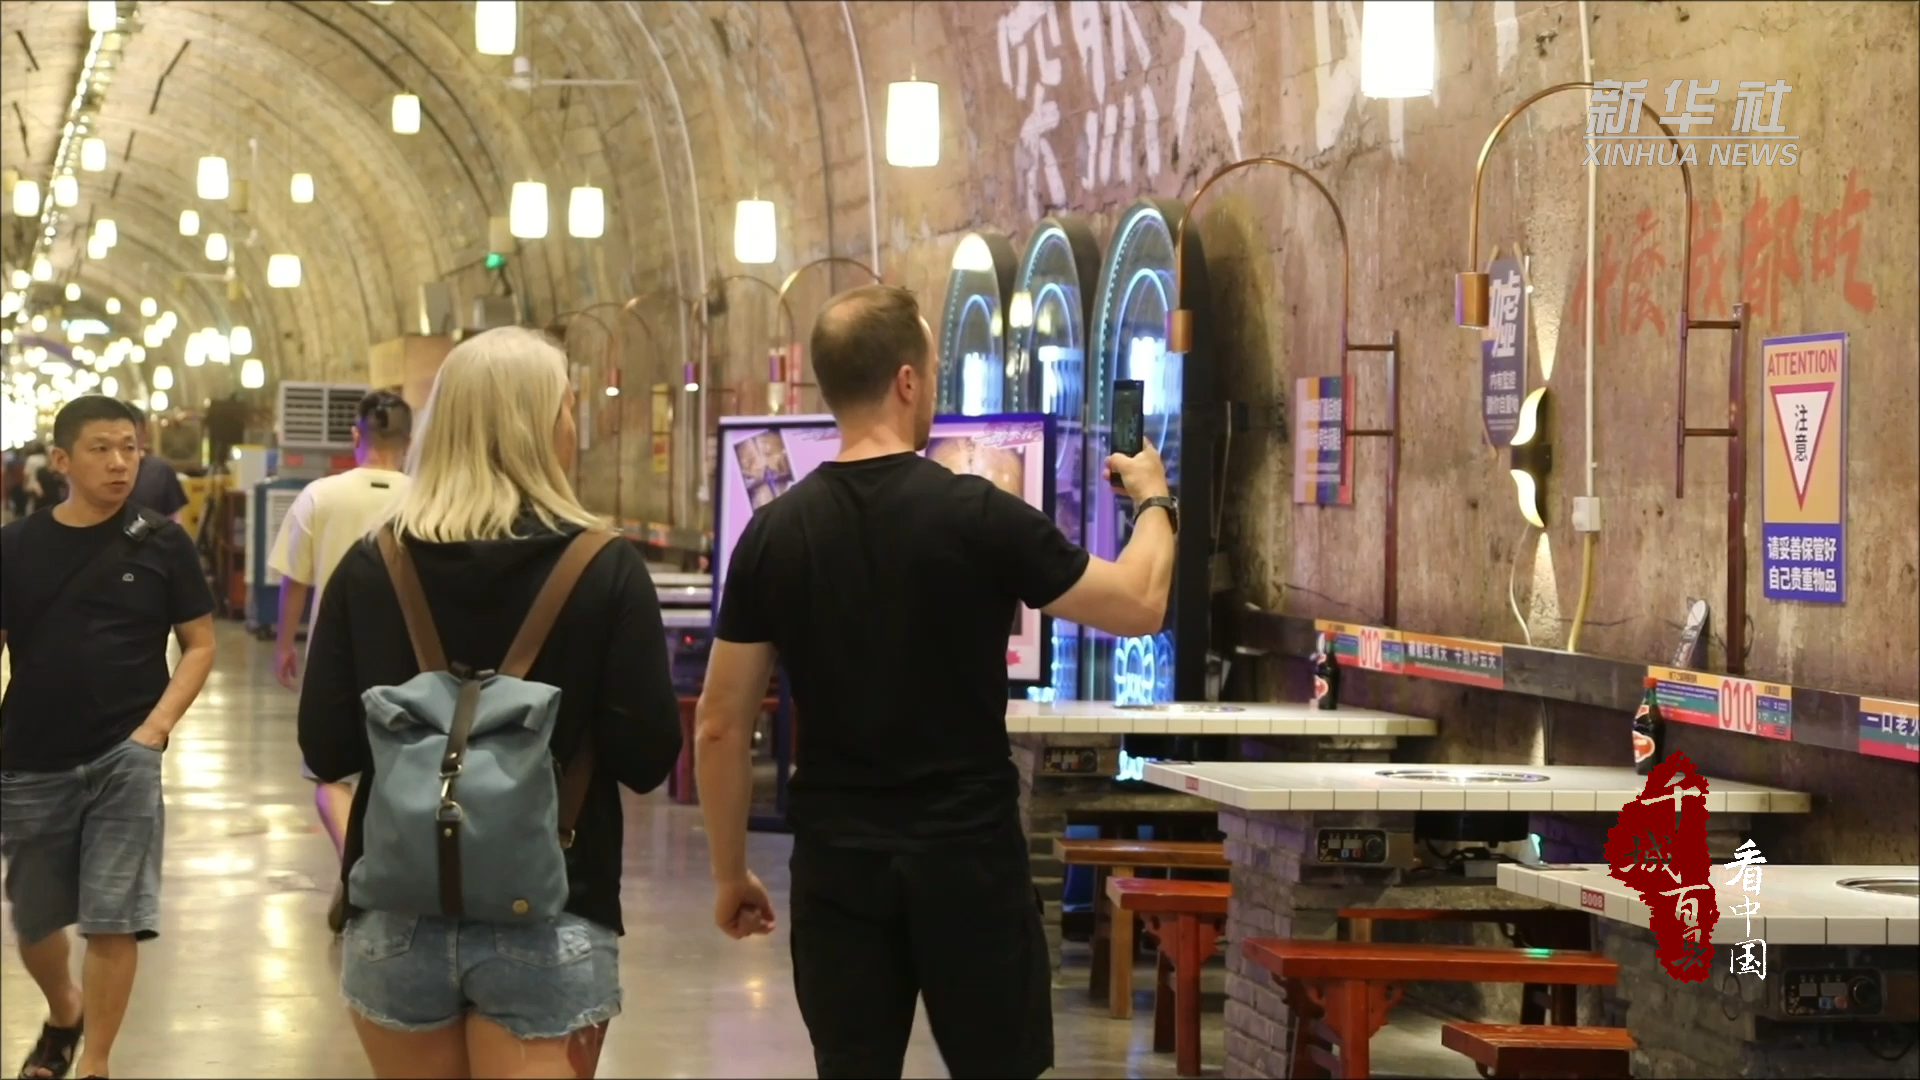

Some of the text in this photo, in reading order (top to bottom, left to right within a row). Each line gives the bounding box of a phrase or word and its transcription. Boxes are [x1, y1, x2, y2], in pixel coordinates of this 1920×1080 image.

[1767, 348, 1837, 378] ATTENTION
[1794, 404, 1809, 463] 注意
[1767, 536, 1837, 563] 请妥善保管好
[1768, 565, 1837, 593] 自己贵重物品
[1360, 628, 1381, 668] 012
[1721, 679, 1754, 732] 010
[1582, 891, 1604, 909] B008
